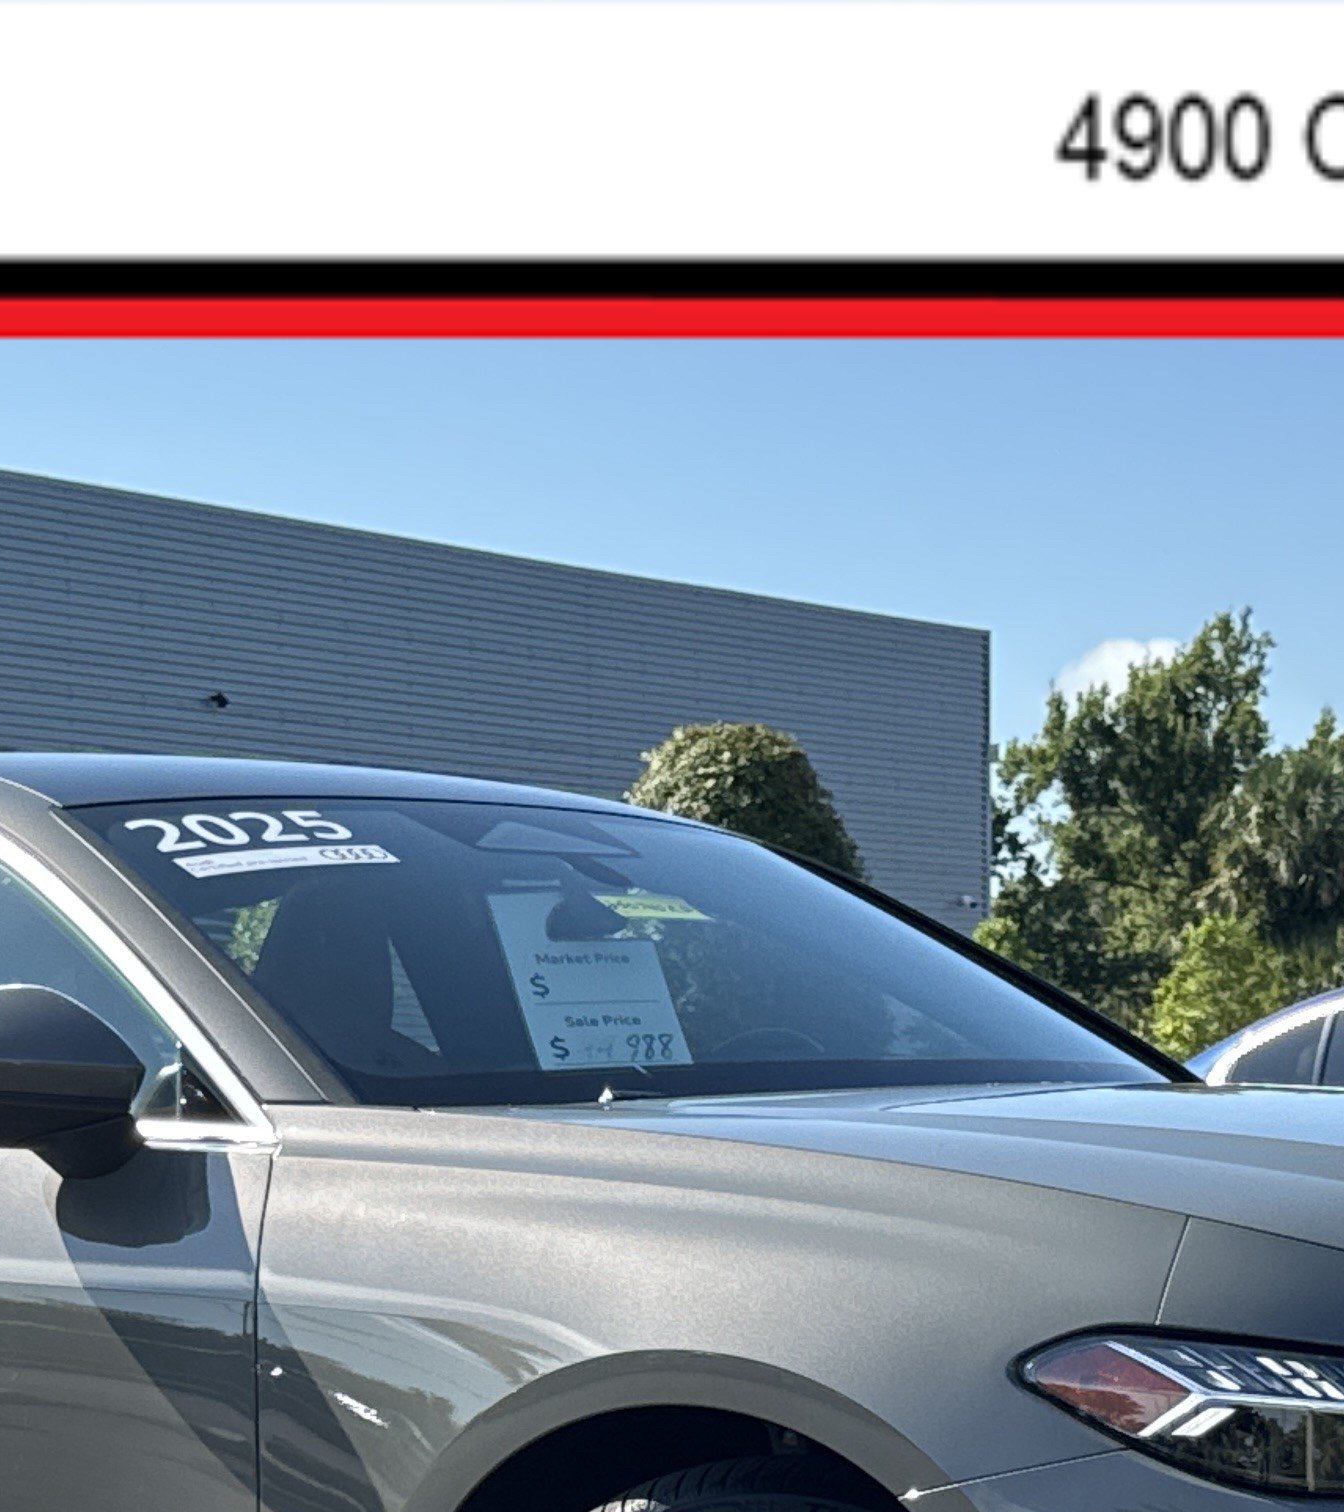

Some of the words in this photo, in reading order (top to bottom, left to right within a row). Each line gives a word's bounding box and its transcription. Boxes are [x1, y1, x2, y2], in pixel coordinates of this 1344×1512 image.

[124, 810, 353, 853] 2025
[534, 952, 590, 965] Market
[594, 953, 631, 965] Price
[529, 972, 551, 999] $
[564, 1015, 599, 1027] Sale
[602, 1014, 642, 1027] Price
[549, 1035, 571, 1061] $
